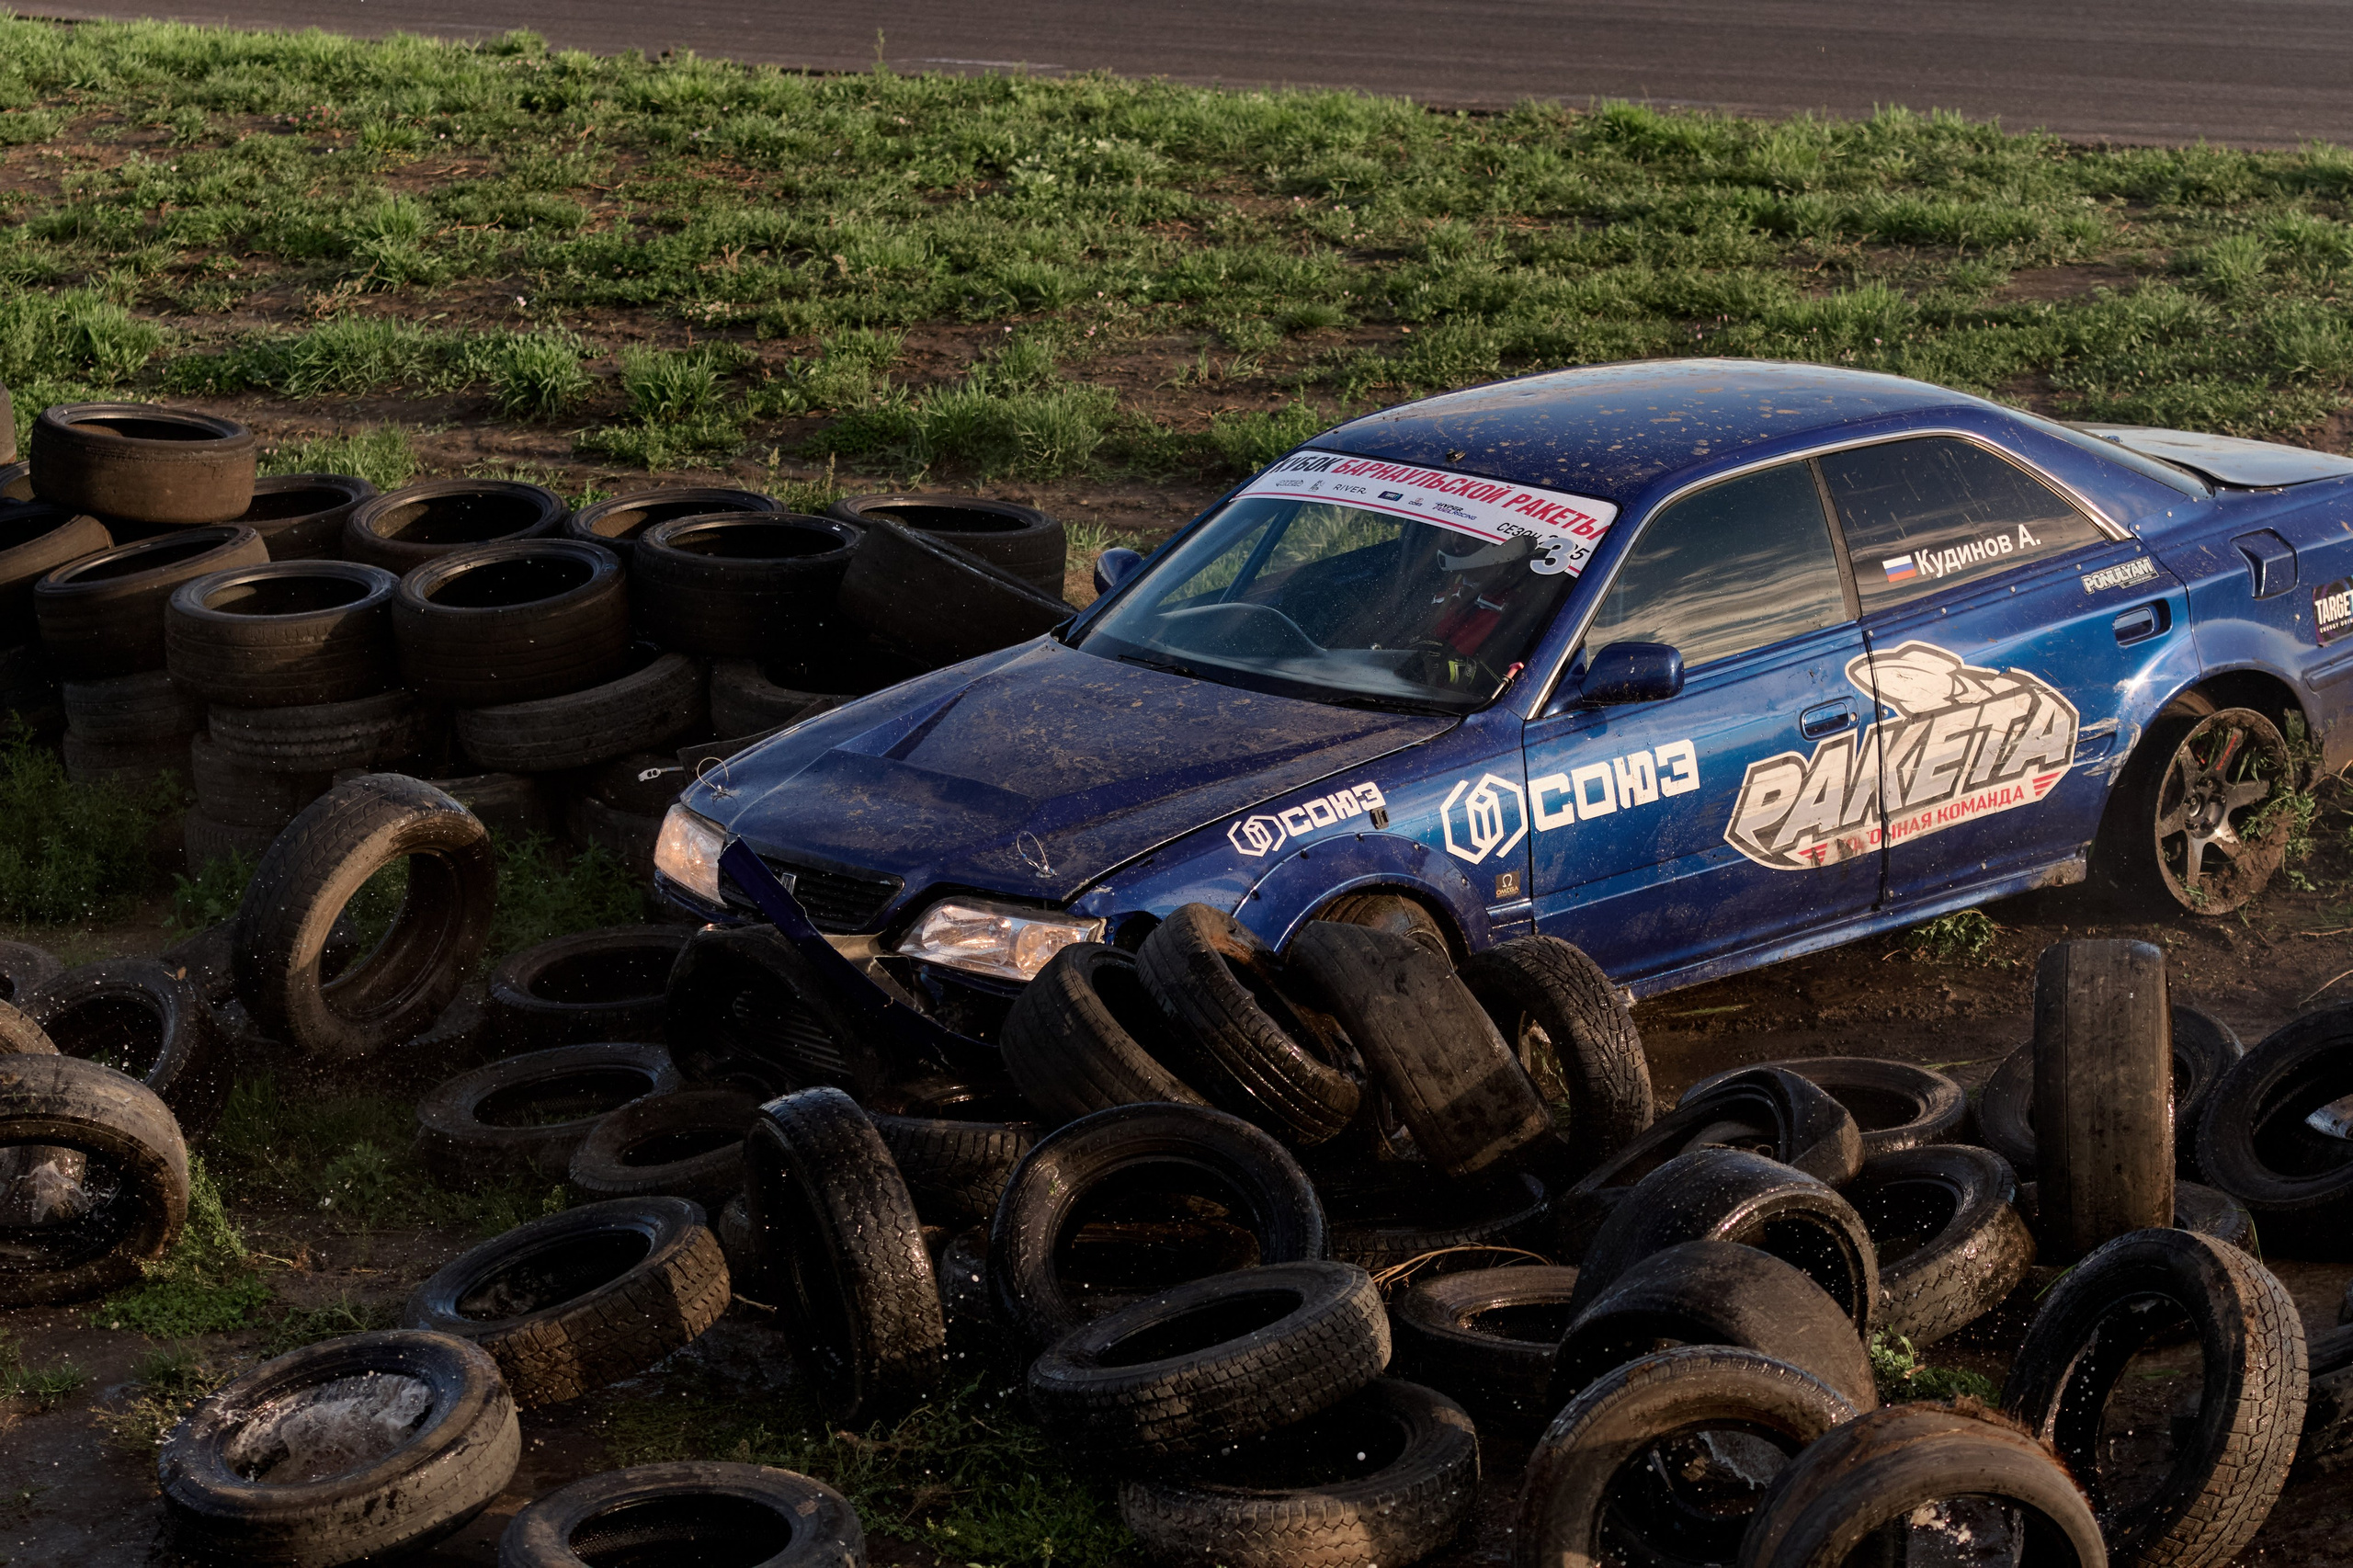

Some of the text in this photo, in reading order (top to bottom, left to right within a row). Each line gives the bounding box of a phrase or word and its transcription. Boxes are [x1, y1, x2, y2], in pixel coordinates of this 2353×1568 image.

[1331, 460, 1517, 505] БАРНАУЛЬСКОЙ
[1501, 493, 1609, 540] РАКЕТЫ
[1333, 483, 1367, 494] RIVER
[1529, 537, 1575, 575] 3
[1915, 524, 2041, 578] Кудинов А.
[2083, 558, 2154, 593] PONULYAM
[1528, 739, 1699, 832] СОЮЗ
[1734, 689, 2070, 855] РАКЕТА
[1279, 781, 1385, 837] СОЮЗ
[1938, 785, 2024, 824] КОМАНДА
[1496, 886, 1519, 895] OMEGA
